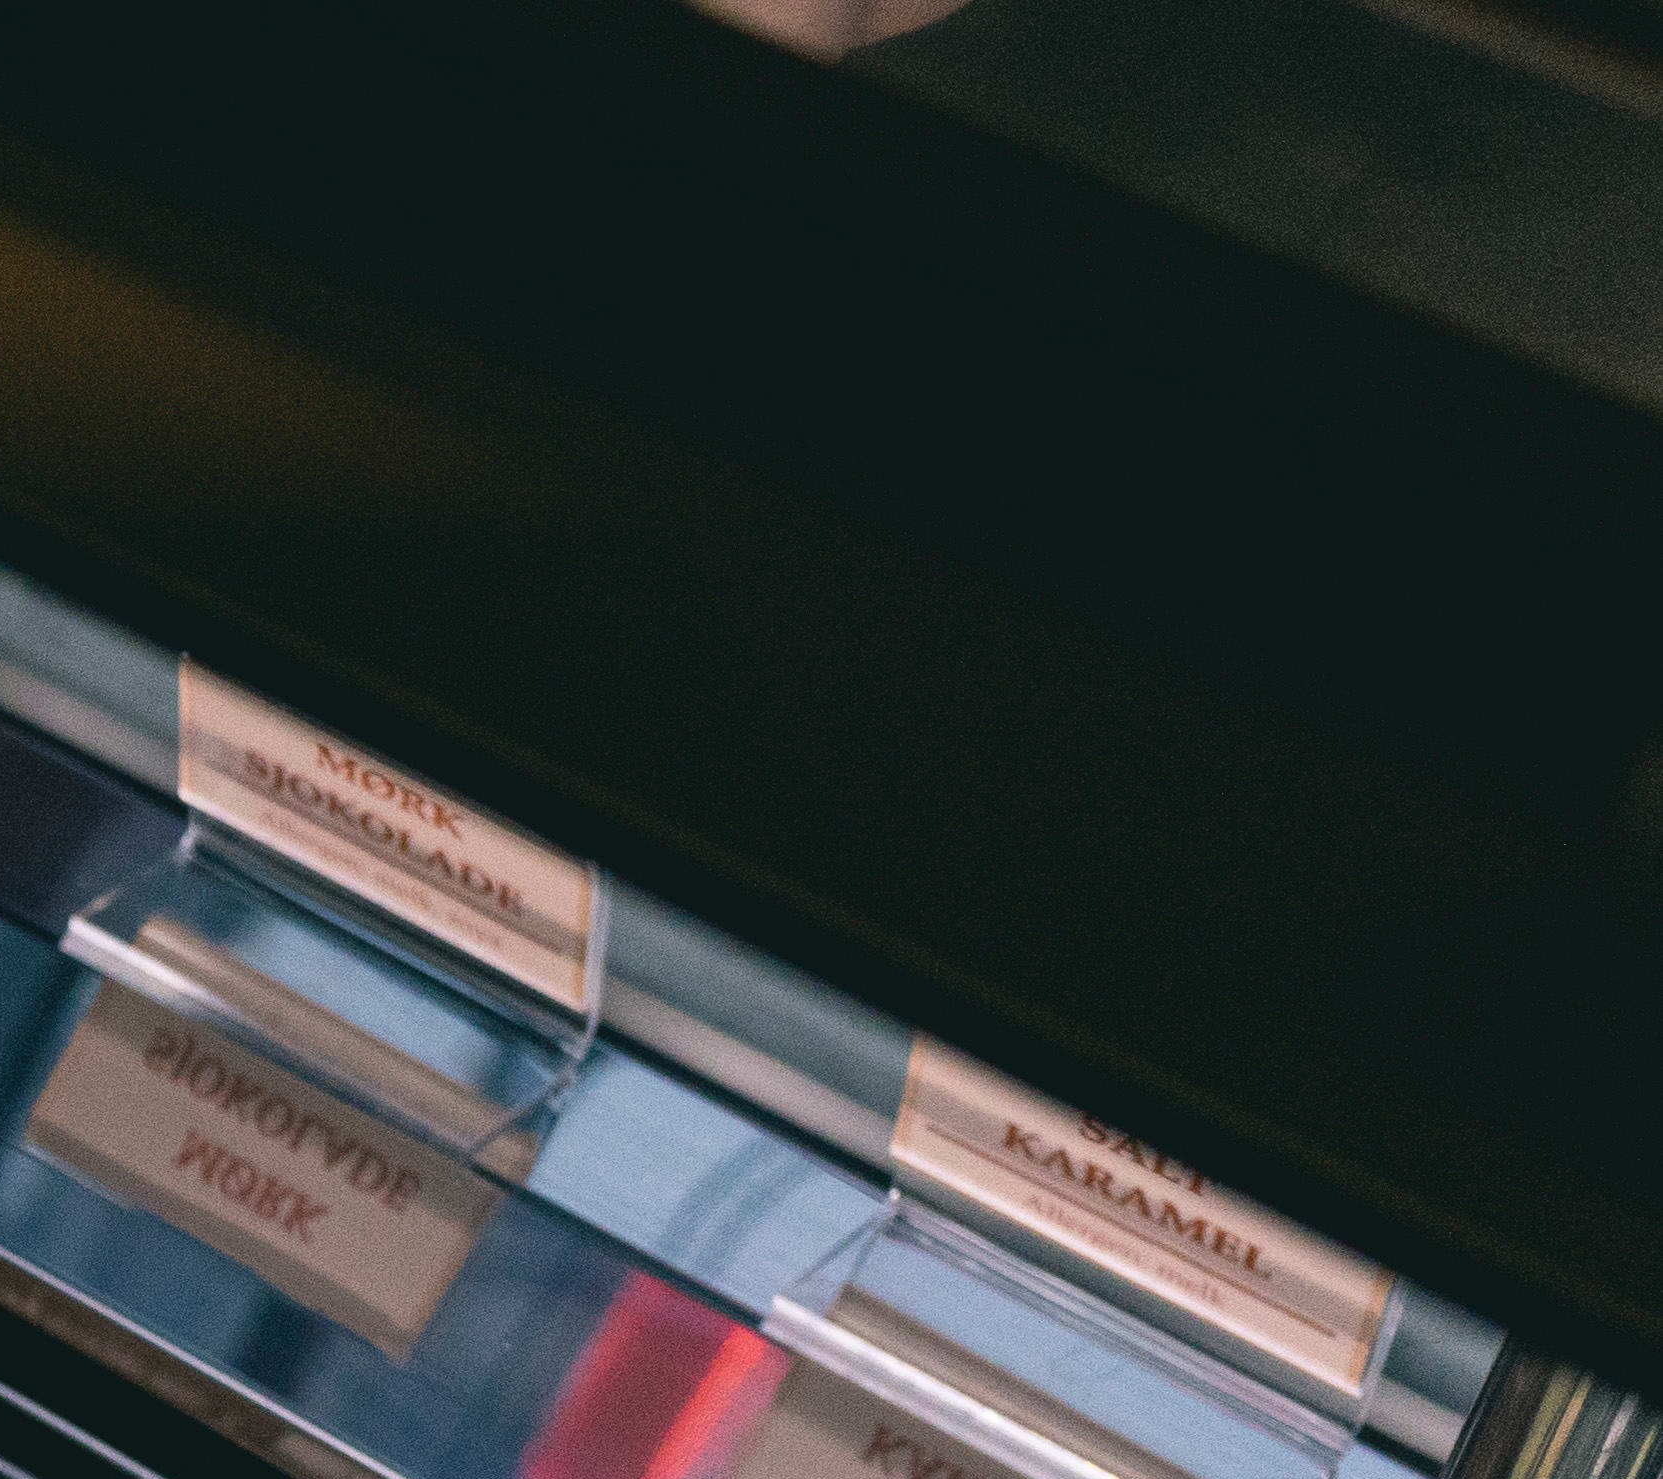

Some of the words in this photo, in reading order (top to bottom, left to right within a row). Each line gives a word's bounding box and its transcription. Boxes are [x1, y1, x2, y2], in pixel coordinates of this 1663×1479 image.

[244, 748, 525, 912] SJOKOLADE
[1005, 1123, 1271, 1281] KARAMEL
[1080, 1112, 1209, 1195] SALT
